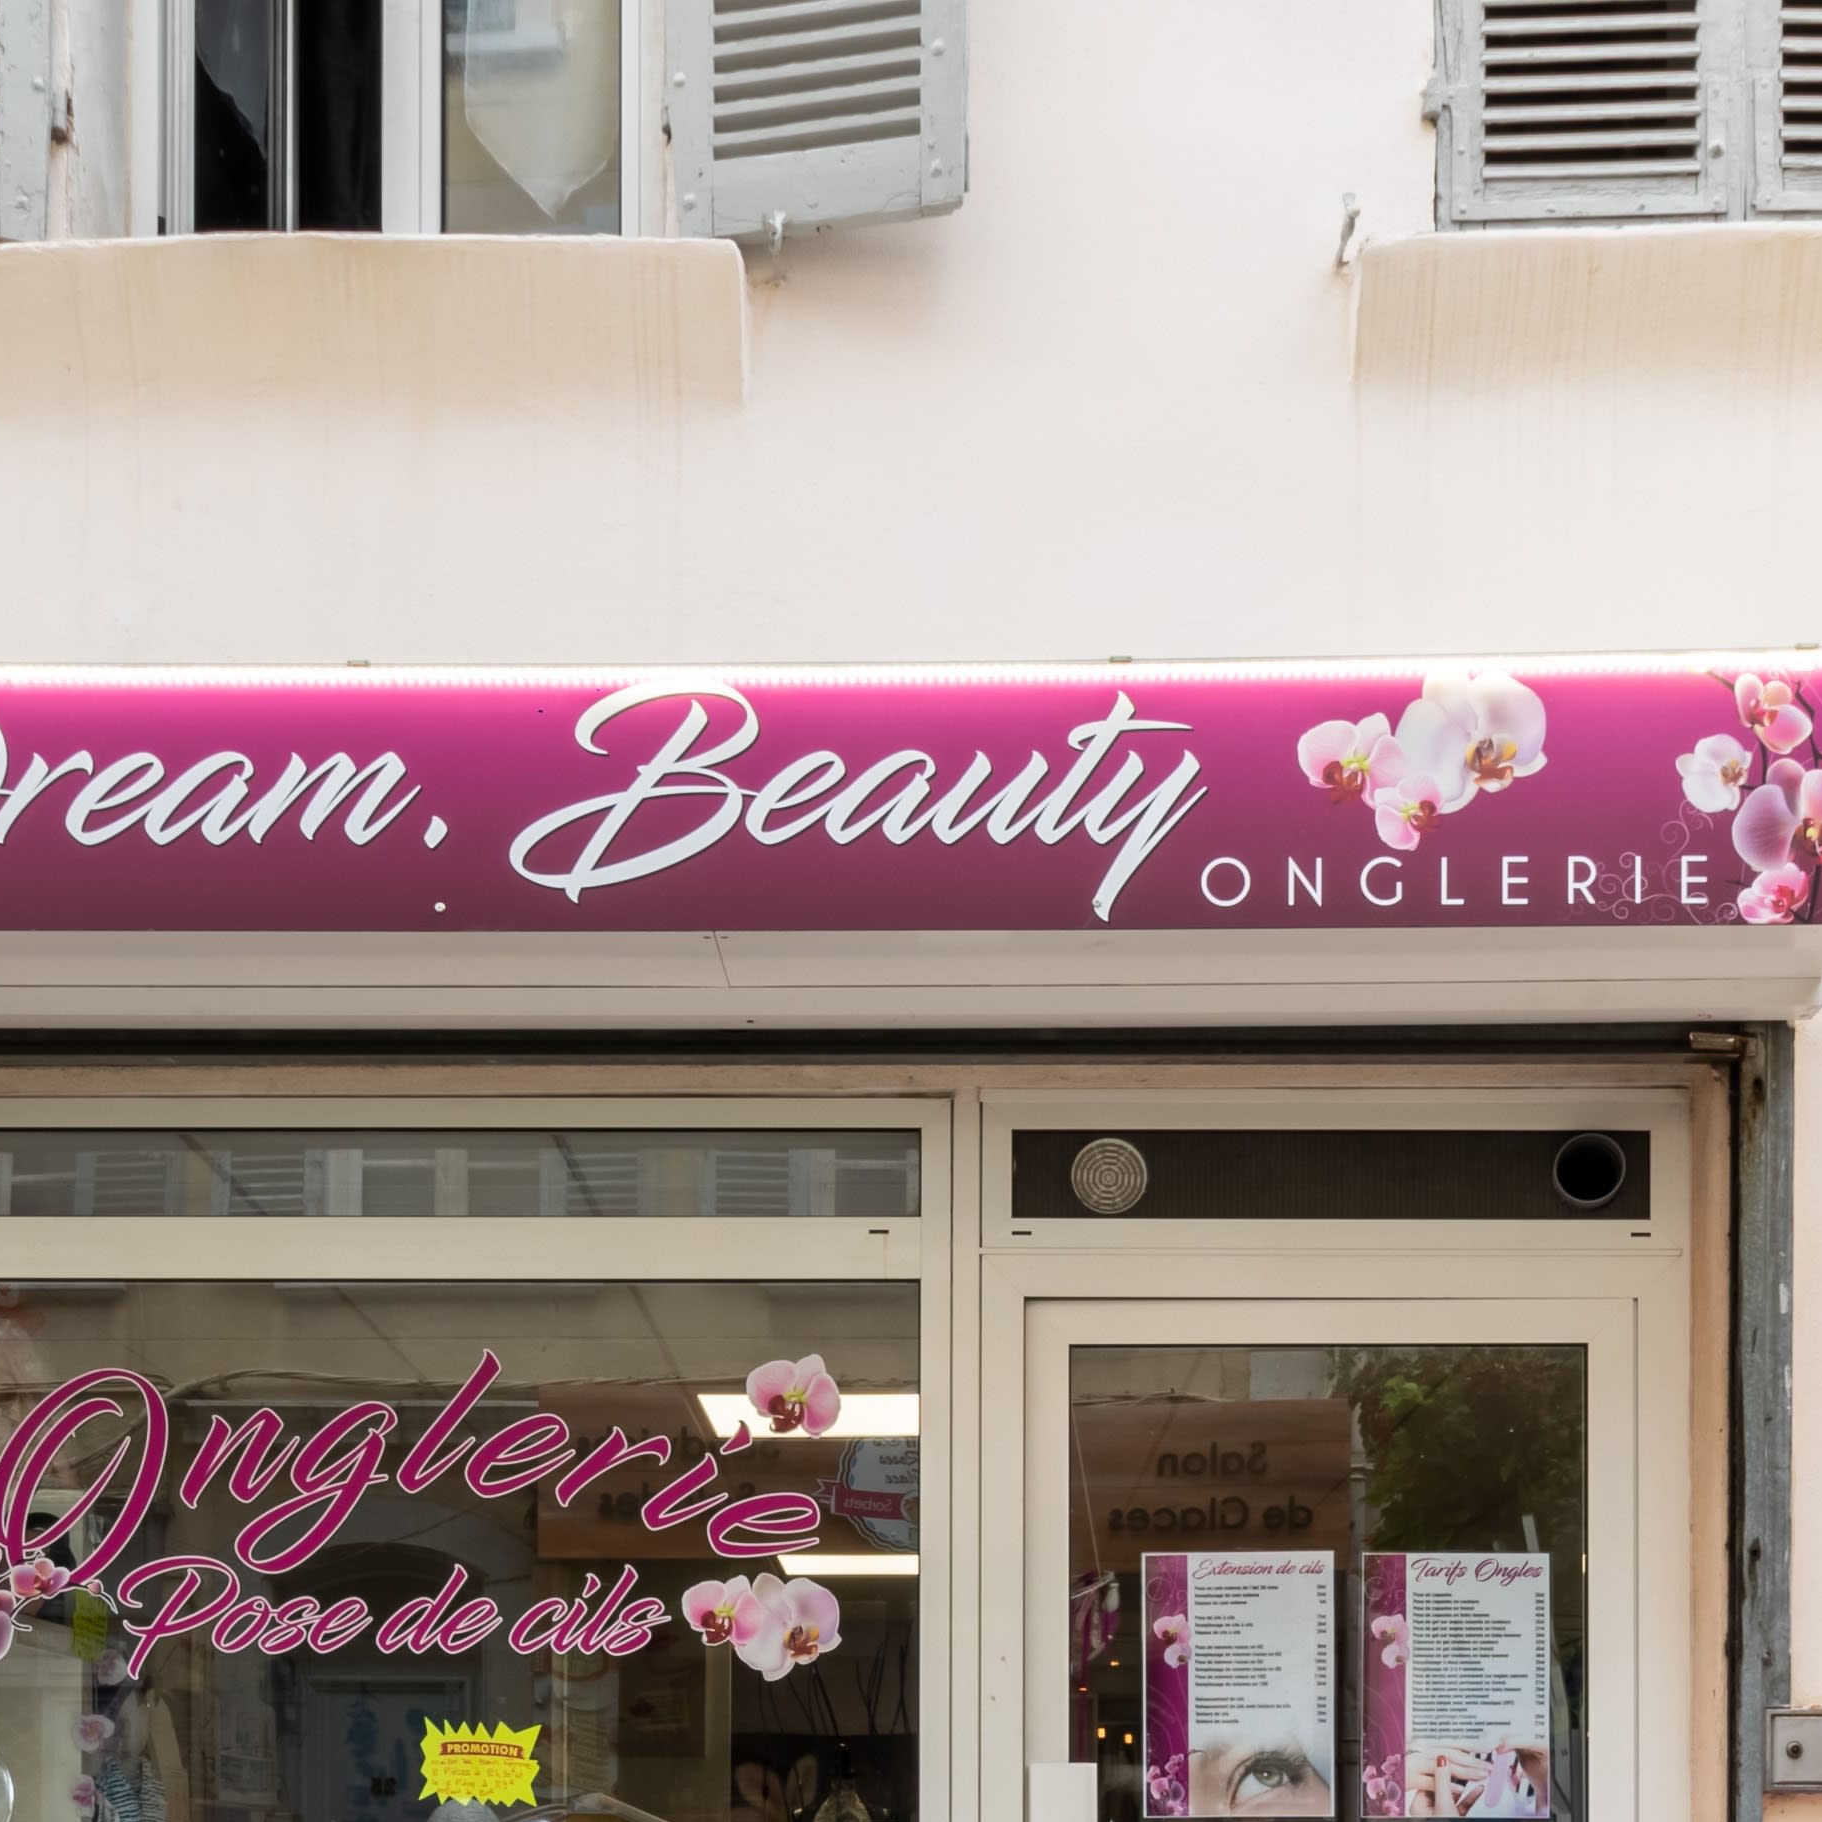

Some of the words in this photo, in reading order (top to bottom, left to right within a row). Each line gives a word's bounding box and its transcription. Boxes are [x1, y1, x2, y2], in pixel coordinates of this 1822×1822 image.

[509, 679, 1207, 922] Beauty
[1201, 855, 1708, 907] ONGLERIE
[1192, 1559, 1272, 1580] Extension
[1276, 1560, 1296, 1575] de
[1299, 1560, 1325, 1575] cils
[1411, 1557, 1468, 1586] Tarifs
[1475, 1557, 1543, 1587] Ongles
[119, 1556, 372, 1680] Pose
[376, 1564, 502, 1655] de
[509, 1564, 671, 1656] cils
[446, 1743, 519, 1756] PROMOTION
